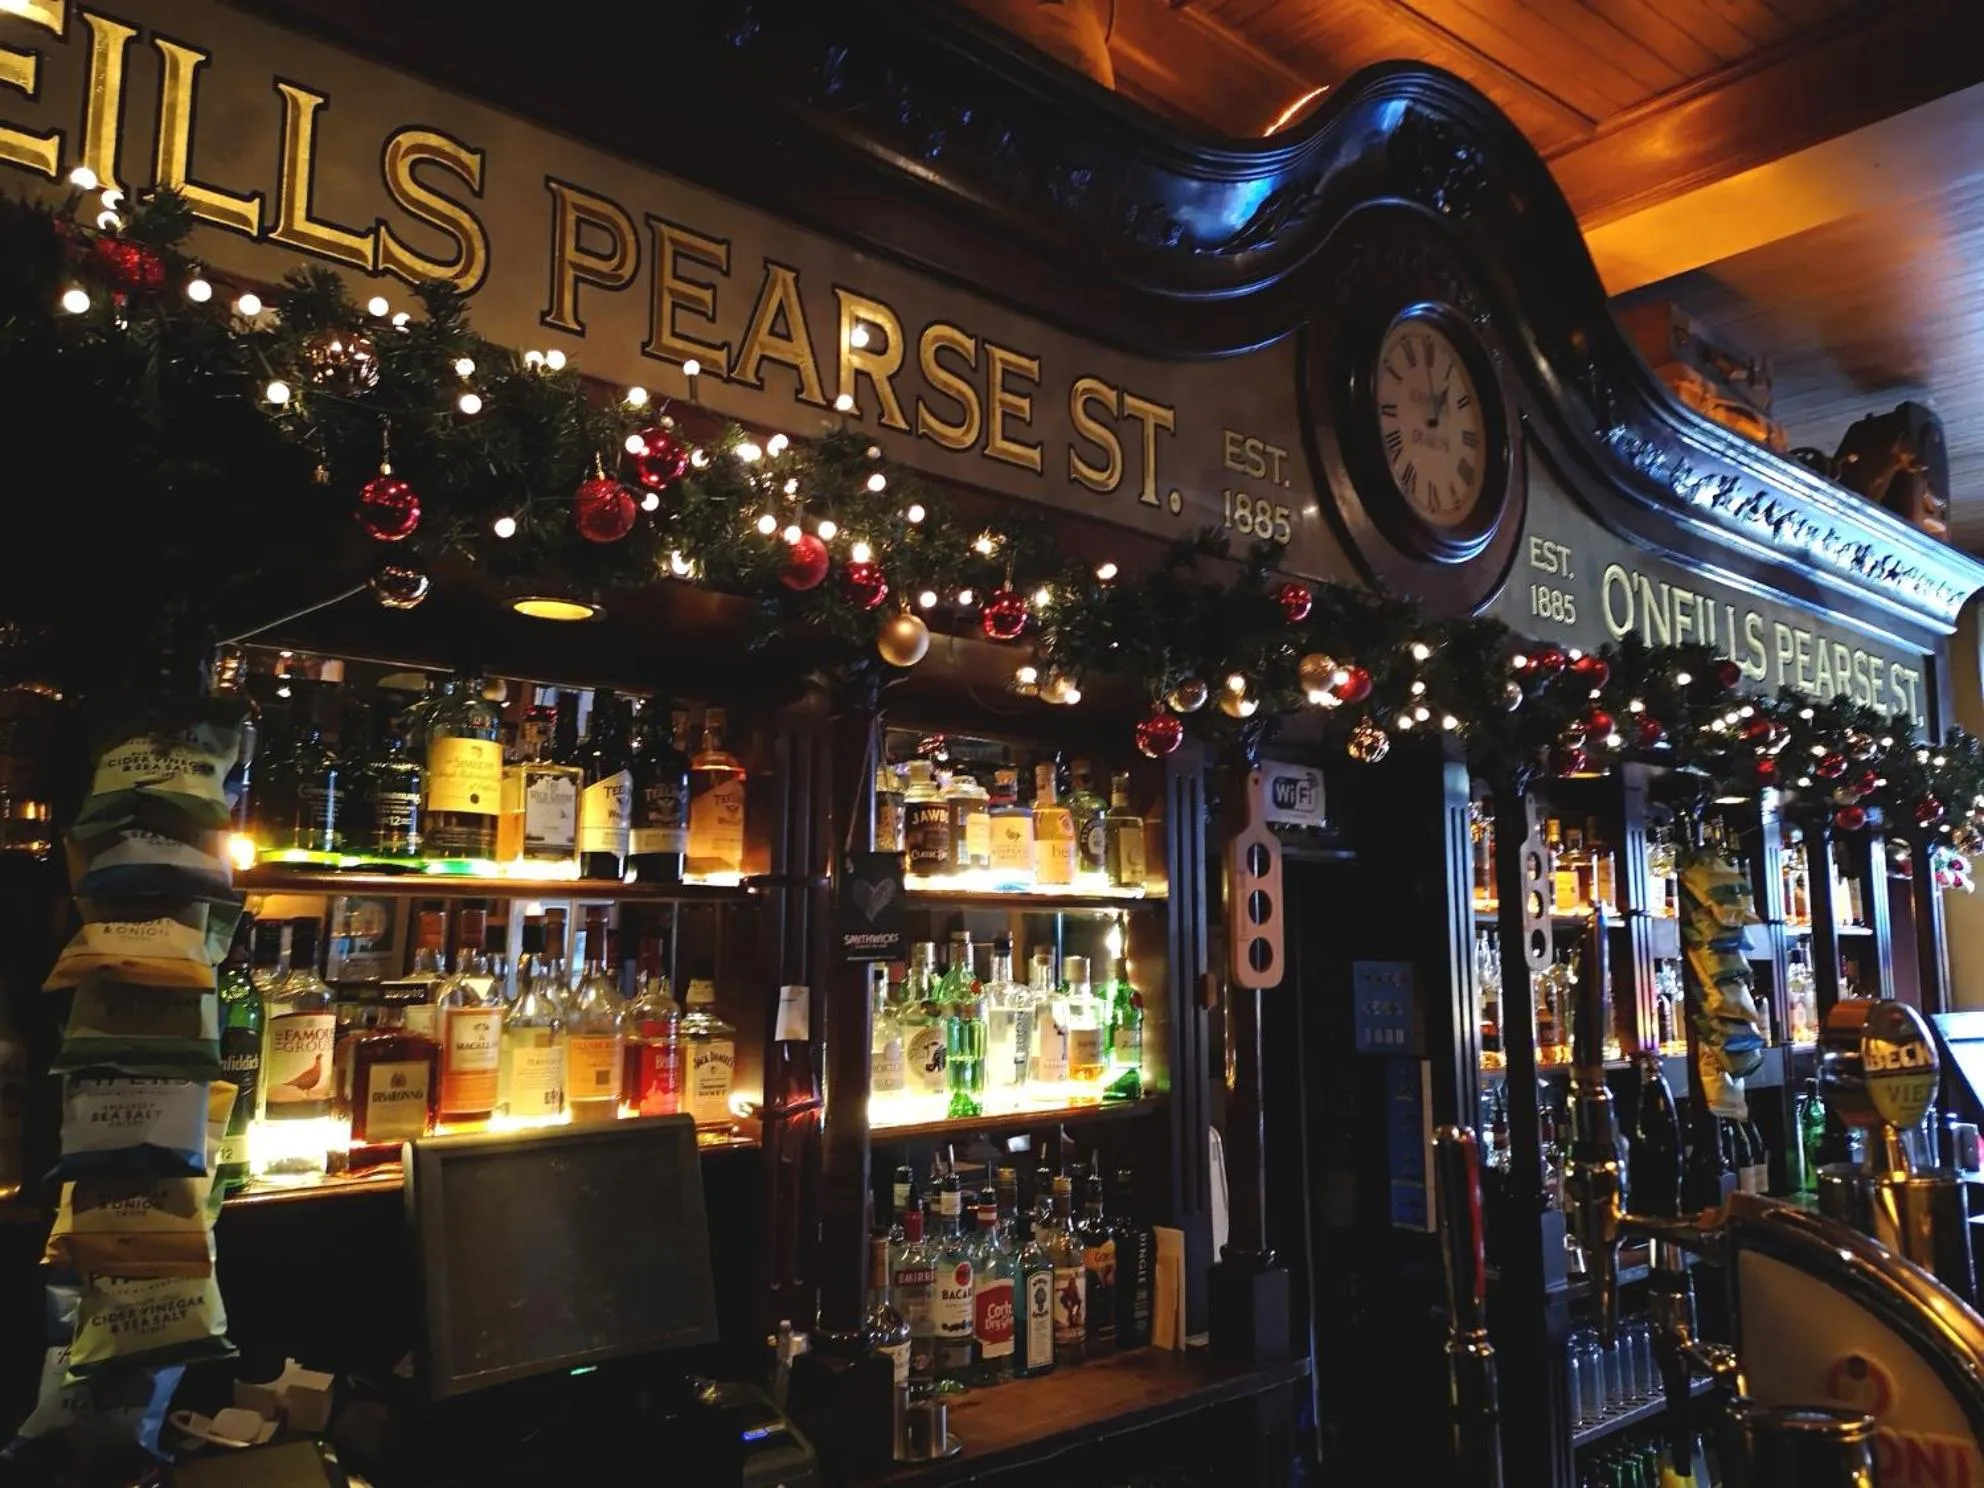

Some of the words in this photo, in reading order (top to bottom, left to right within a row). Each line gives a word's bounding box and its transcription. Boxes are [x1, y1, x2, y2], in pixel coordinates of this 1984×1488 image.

[541, 175, 1042, 475] PEARSE
[1069, 375, 1182, 514] ST.
[1223, 430, 1290, 488] EST.
[1223, 489, 1292, 545] 1885
[1529, 536, 1576, 581] EST.
[1530, 584, 1576, 625] 1885
[1774, 622, 1887, 716] PEARSE
[91, 1109, 121, 1122] SEA
[125, 1109, 163, 1121] SALT
[92, 1308, 138, 1327] CIDER
[141, 1296, 205, 1316] VINEGAR
[123, 1315, 152, 1332] SEA
[152, 1309, 188, 1325] SALT
